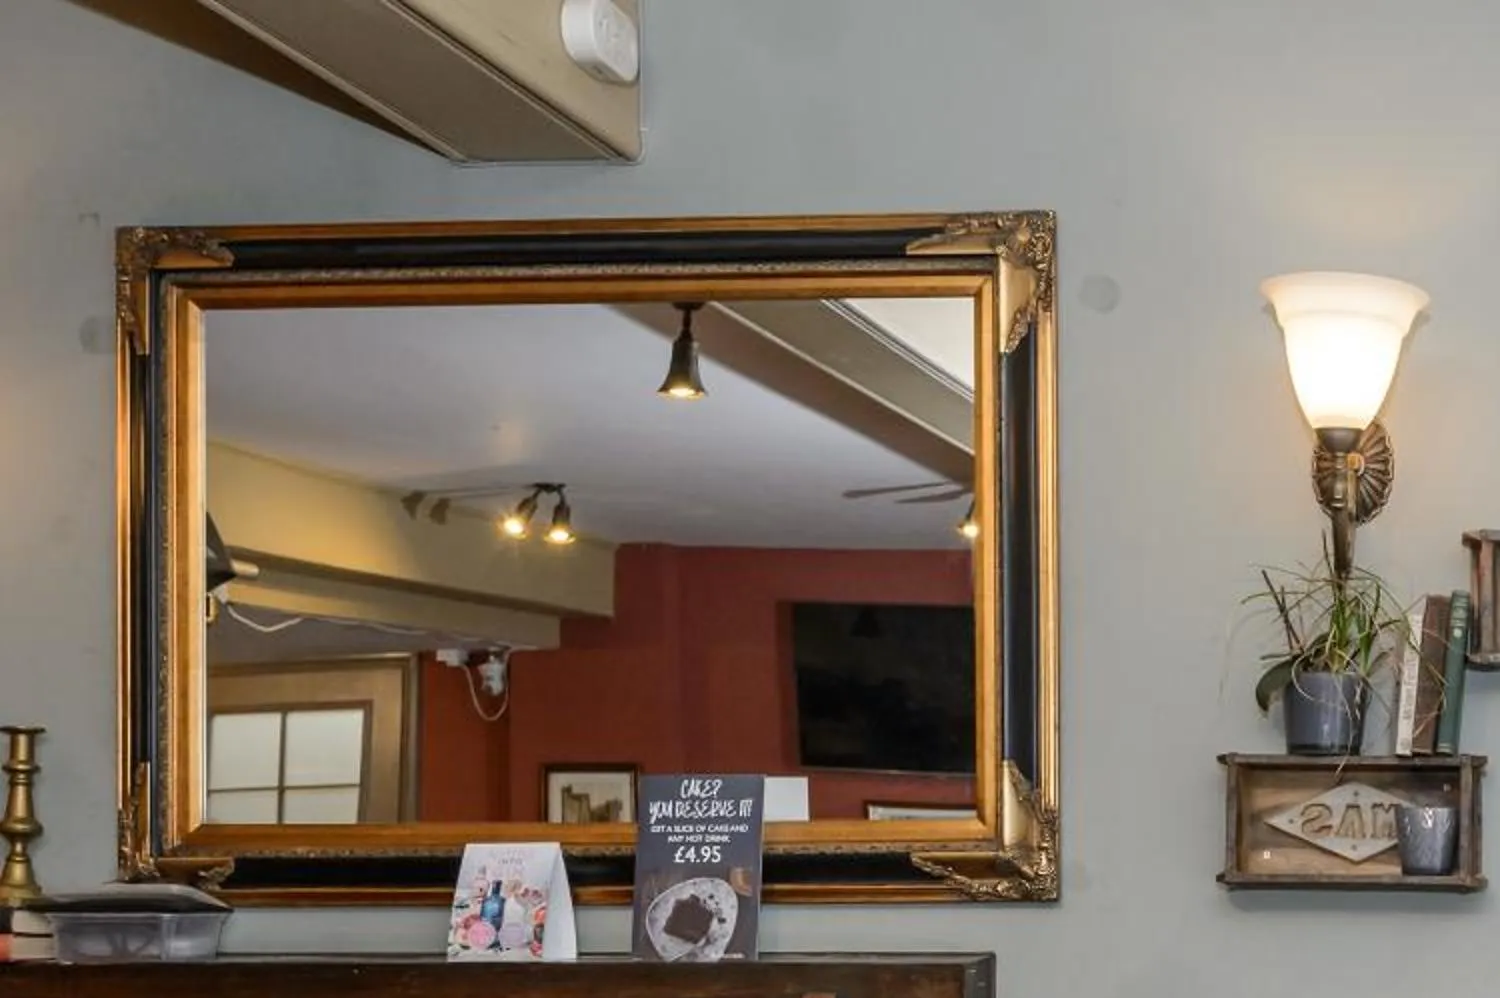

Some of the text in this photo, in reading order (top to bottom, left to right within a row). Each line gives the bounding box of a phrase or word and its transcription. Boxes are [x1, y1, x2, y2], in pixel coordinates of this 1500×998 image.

[680, 778, 723, 799] CAKE?
[675, 800, 737, 820] DESERVE
[674, 846, 721, 863] £4.95
